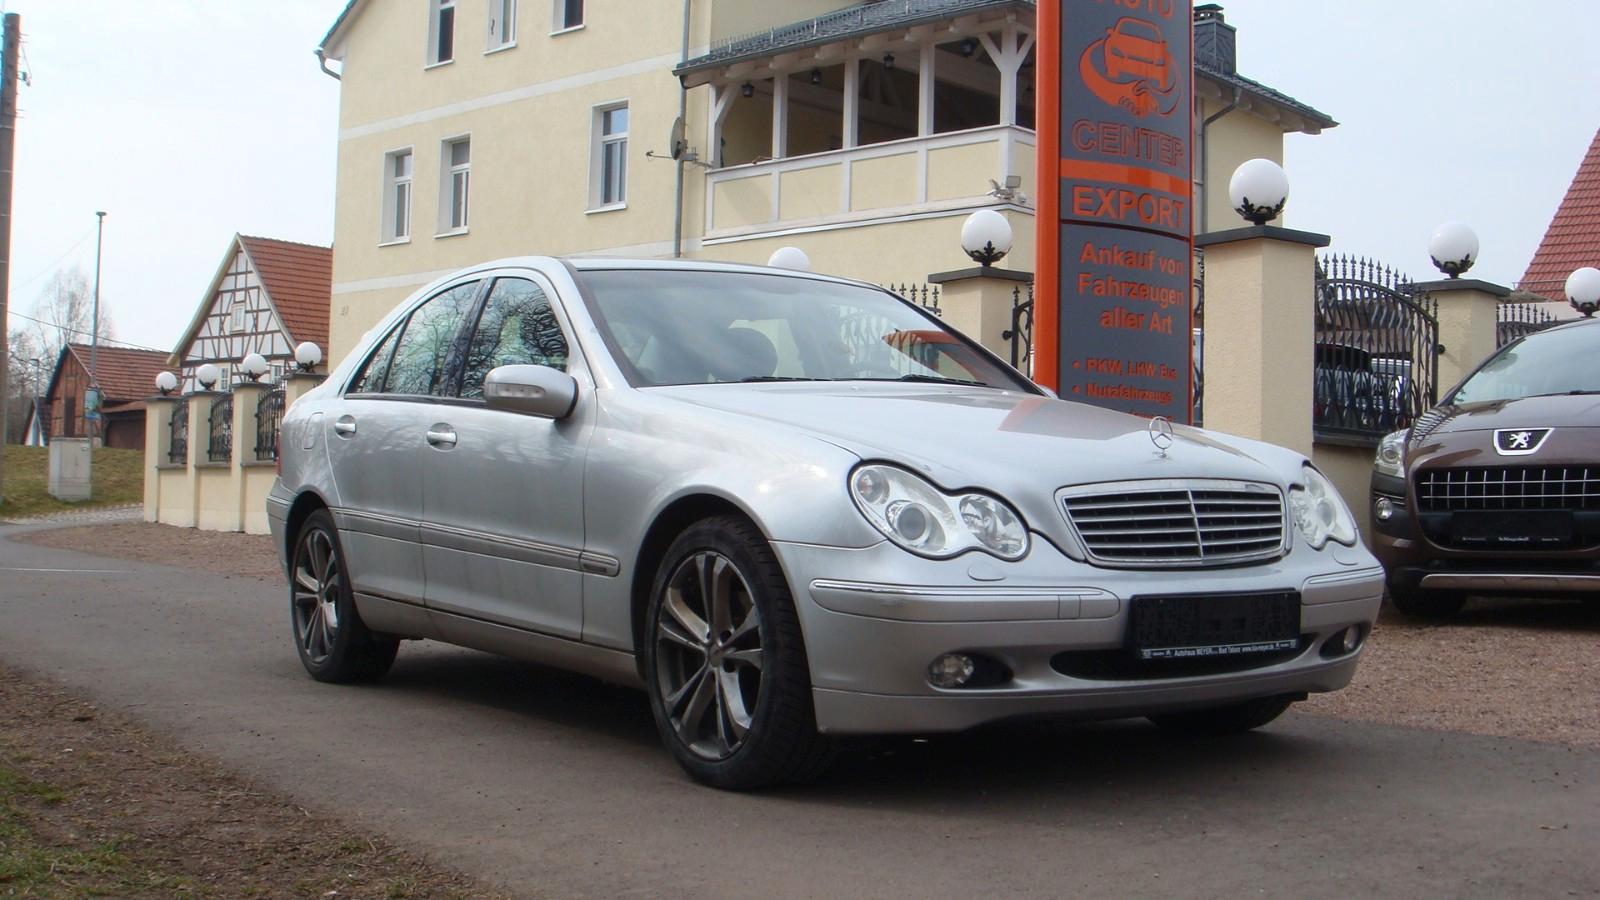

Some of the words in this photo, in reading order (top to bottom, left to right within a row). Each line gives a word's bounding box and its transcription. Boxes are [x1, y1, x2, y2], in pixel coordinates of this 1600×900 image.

[1072, 119, 1184, 168] CENTER
[1072, 185, 1185, 229] EXPORT
[1080, 242, 1155, 270] Ankauf
[1159, 257, 1184, 275] von
[1078, 272, 1184, 308] Fahrzeugen
[1100, 306, 1145, 329] aller
[1150, 312, 1173, 335] Art
